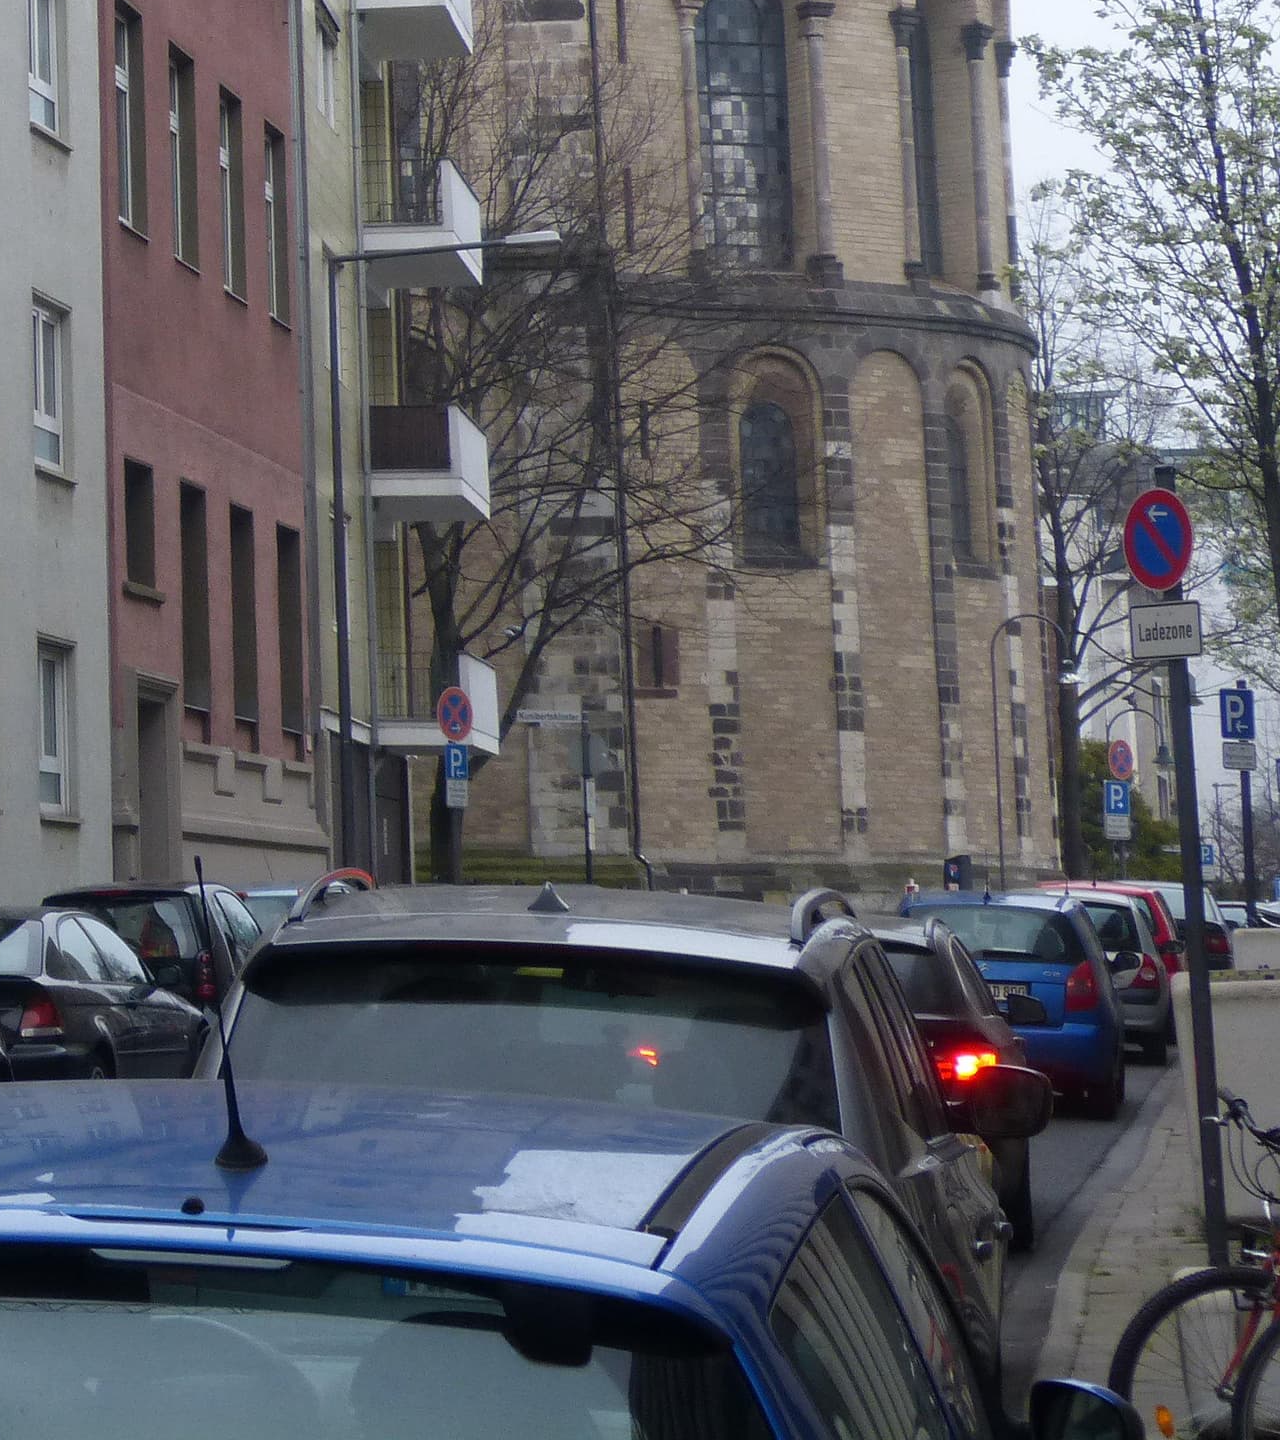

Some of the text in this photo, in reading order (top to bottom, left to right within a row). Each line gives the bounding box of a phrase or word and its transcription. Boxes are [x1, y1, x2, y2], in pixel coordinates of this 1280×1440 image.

[1138, 622, 1193, 642] Ladezone
[1225, 695, 1245, 733] P
[450, 748, 463, 777] P
[1111, 784, 1124, 810] P
[1202, 846, 1210, 861] P
